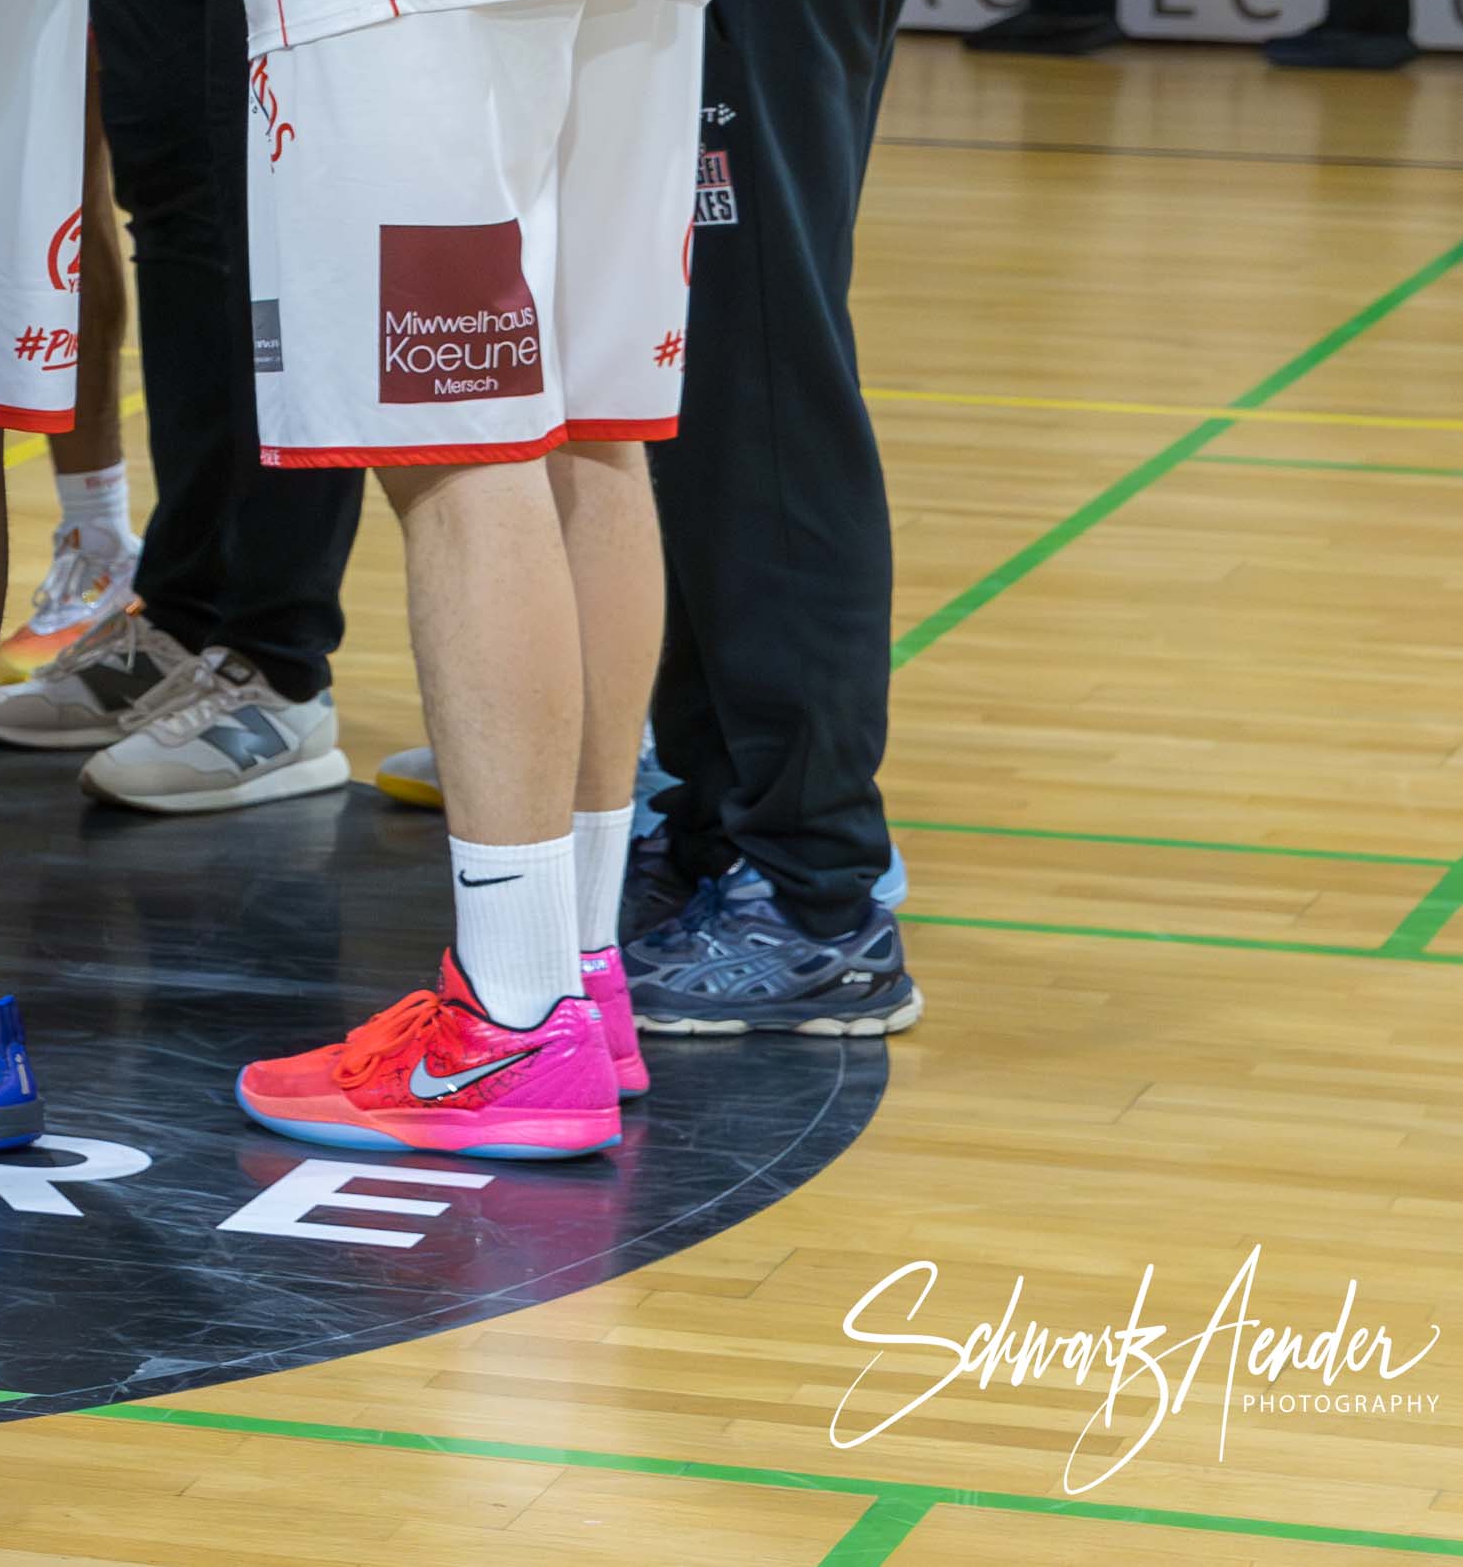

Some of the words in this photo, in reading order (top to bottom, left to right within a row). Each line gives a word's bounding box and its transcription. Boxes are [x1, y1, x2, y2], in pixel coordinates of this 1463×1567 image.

[385, 306, 535, 335] Miwwelhaus
[385, 335, 539, 373] Koeune
[434, 376, 499, 395] Mersch
